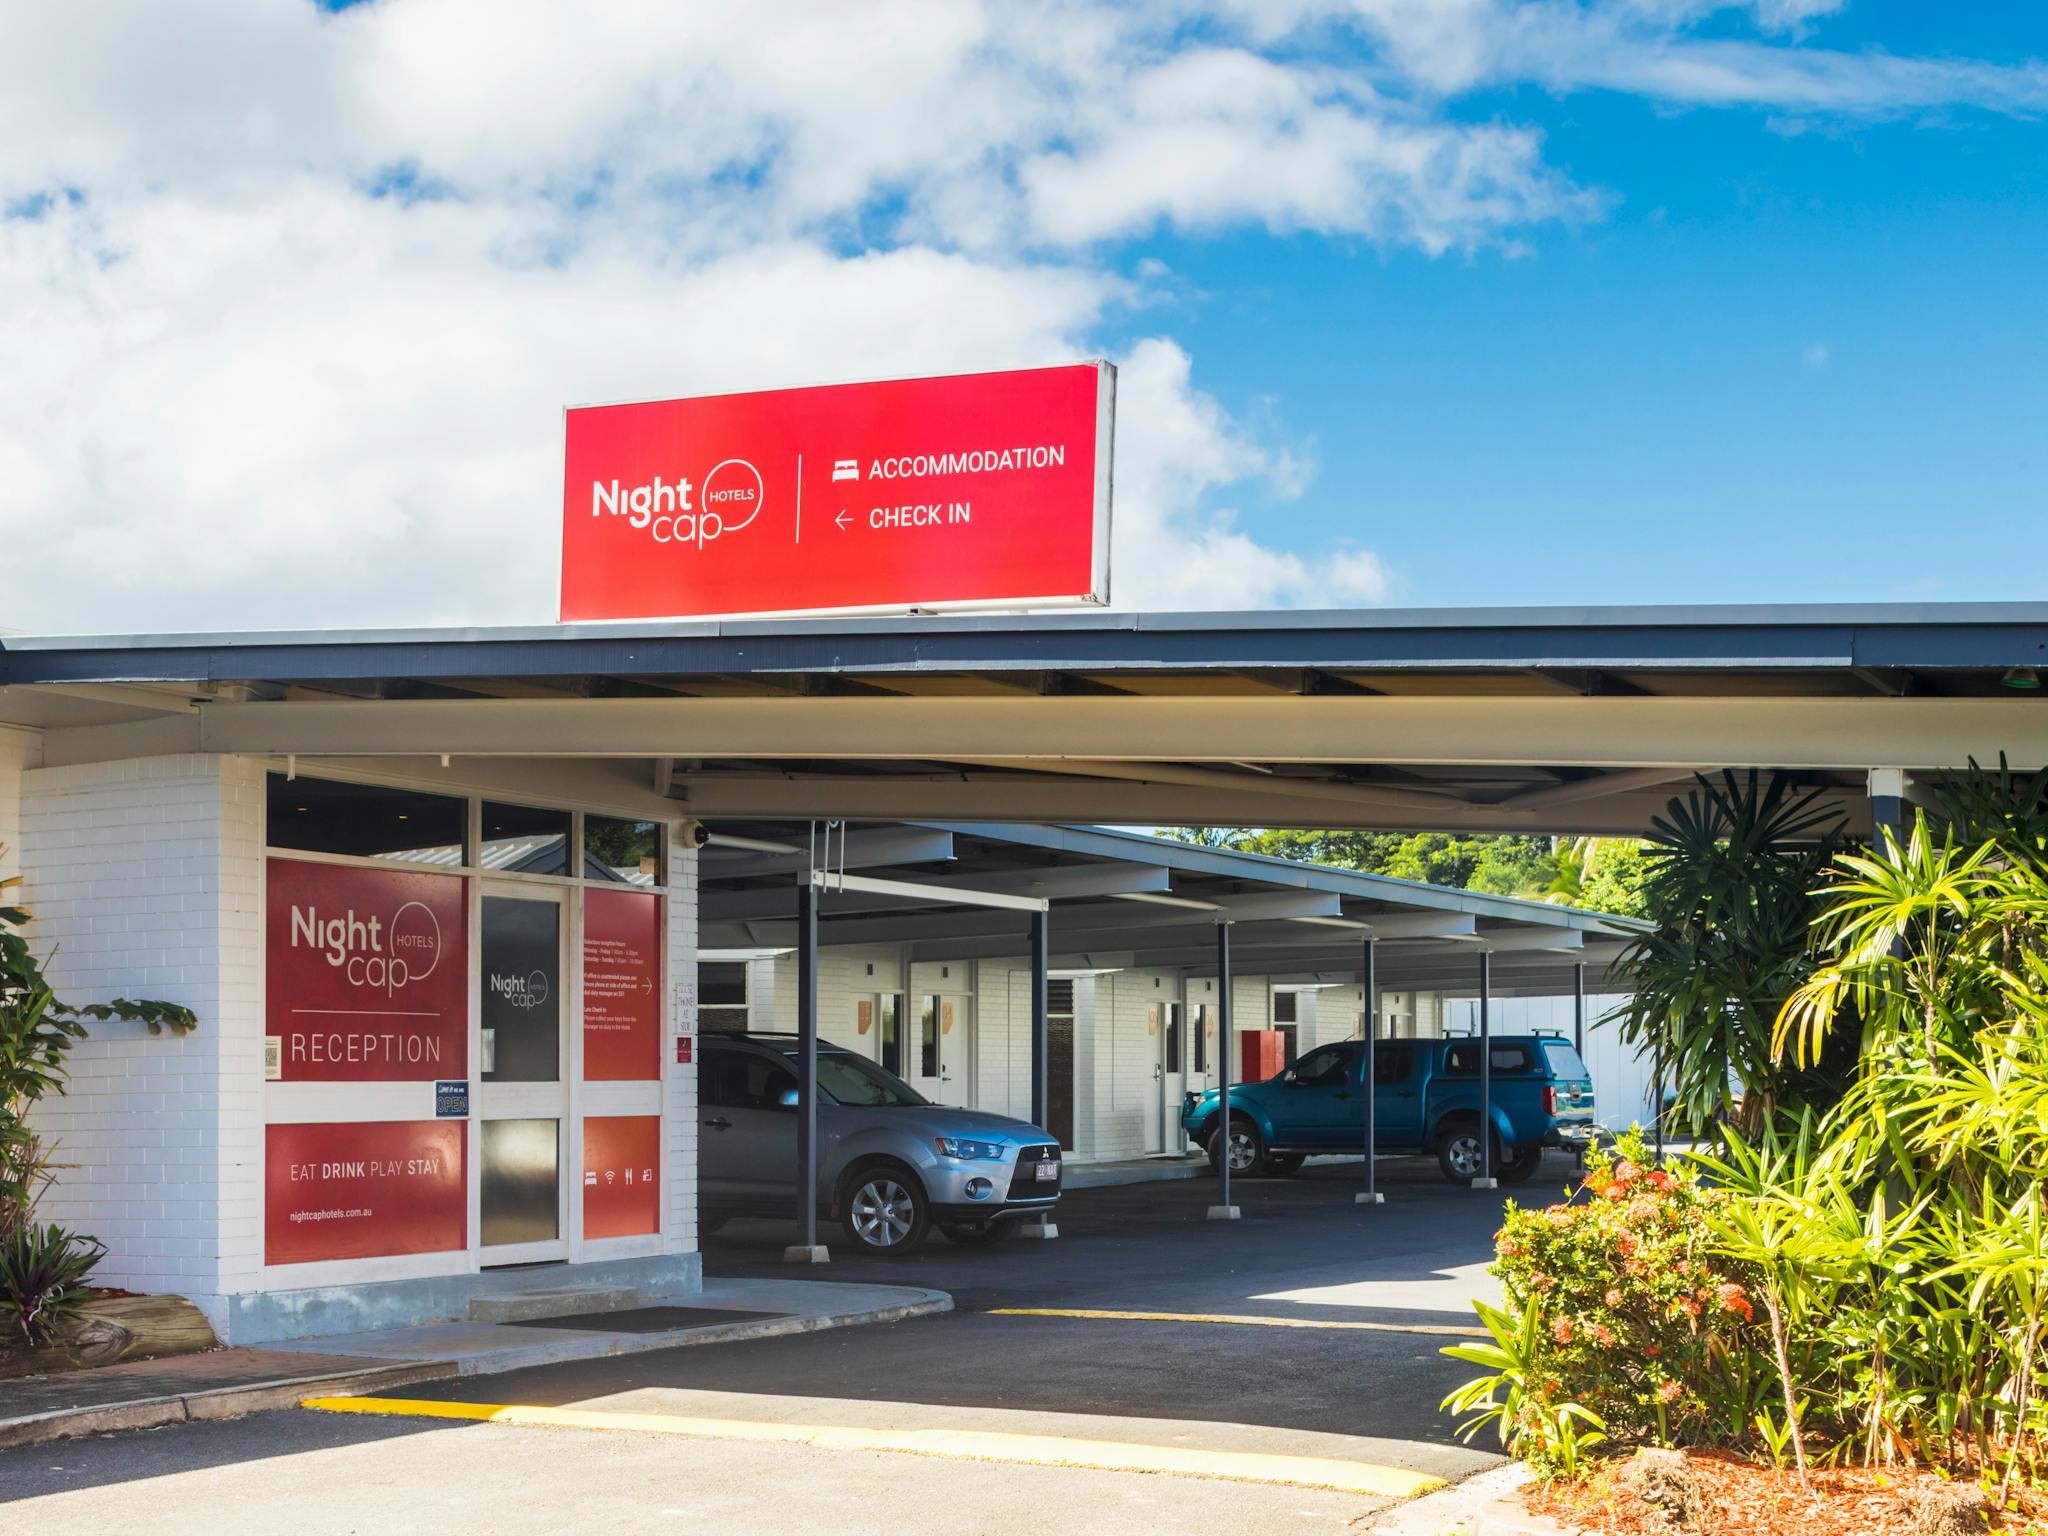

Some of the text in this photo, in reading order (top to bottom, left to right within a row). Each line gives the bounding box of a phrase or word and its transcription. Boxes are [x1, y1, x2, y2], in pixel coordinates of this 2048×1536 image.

[868, 445, 1065, 480] ACCOMMODATION
[592, 477, 693, 529] Night
[709, 488, 755, 502] HOTELS
[869, 502, 971, 529] CHECK IN
[652, 512, 723, 550] cap
[291, 905, 382, 967] Night
[396, 935, 434, 949] HOTELS
[347, 956, 408, 998] cap
[490, 973, 526, 999] Night
[511, 993, 536, 1011] cap
[291, 1033, 440, 1062] RECEPTION
[437, 1096, 468, 1113] OPEN
[291, 1158, 439, 1181] EAT DRINK PLAY STAY
[290, 1207, 372, 1224] nightcaphotels.com.au
